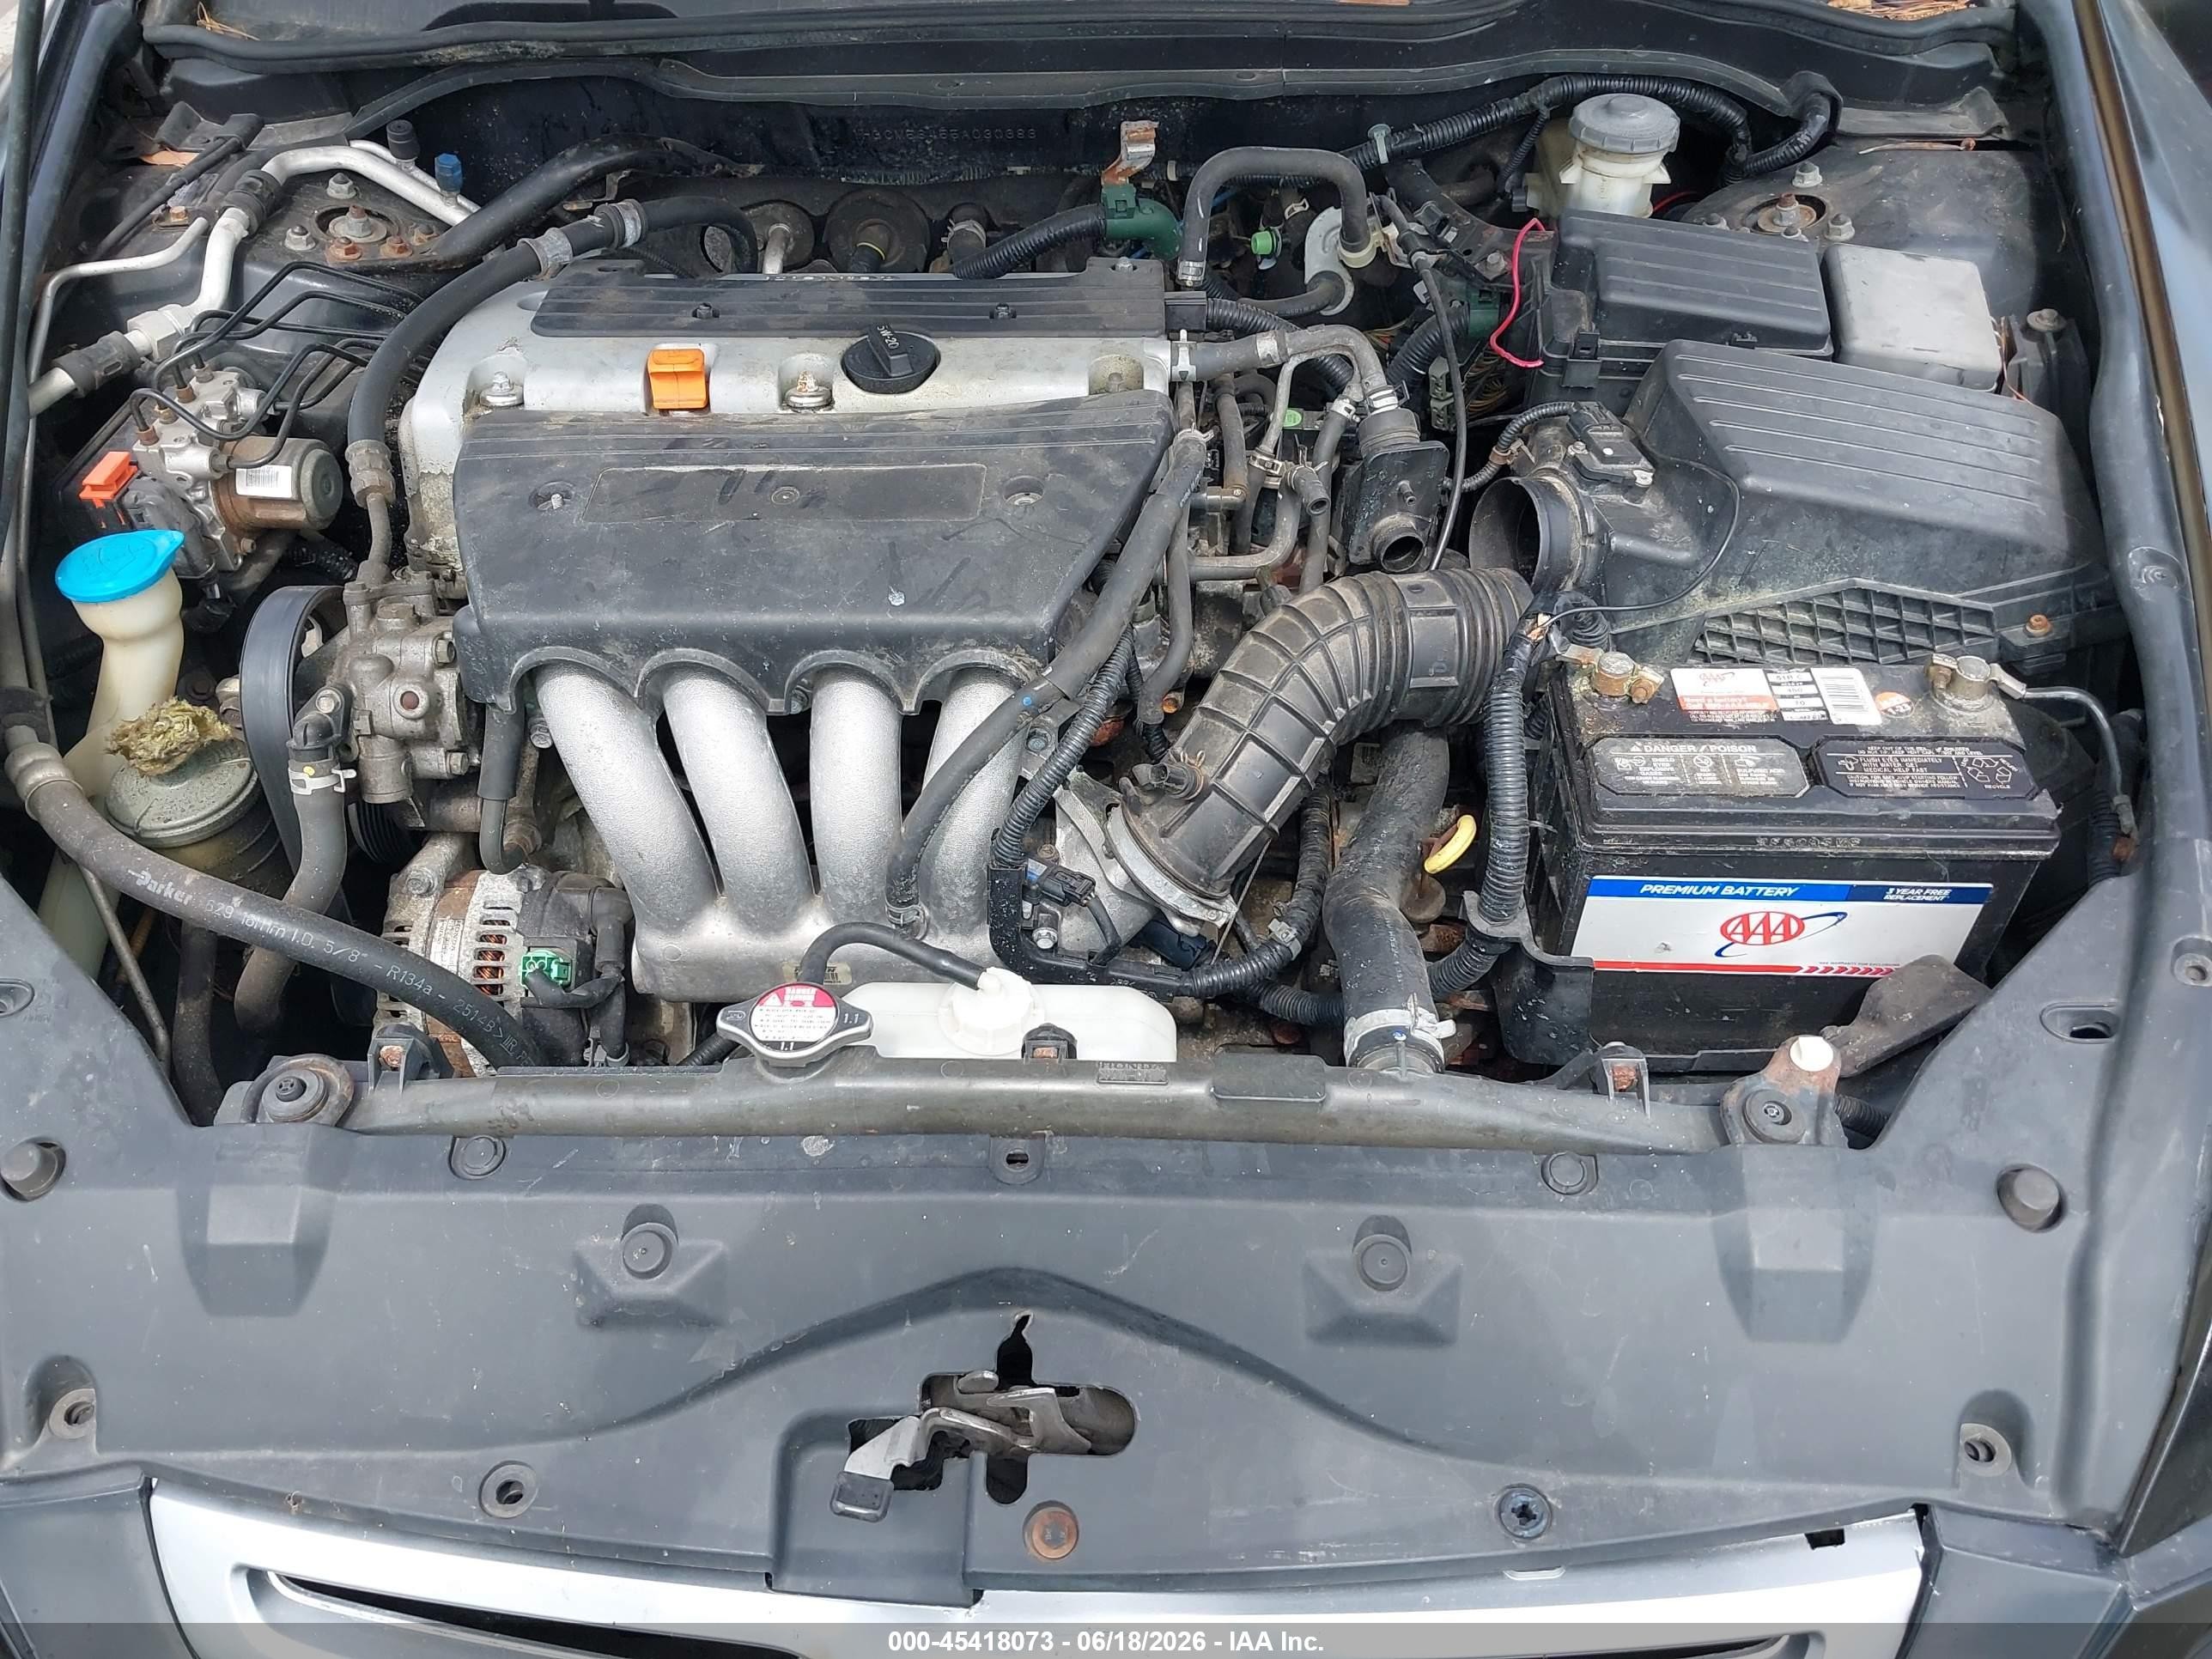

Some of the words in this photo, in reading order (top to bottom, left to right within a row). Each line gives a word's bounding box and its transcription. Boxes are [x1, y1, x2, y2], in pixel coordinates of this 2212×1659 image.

[1710, 744, 1757, 753] POISON
[129, 870, 193, 905] Parker
[1639, 884, 1719, 896] PREMIUM
[1720, 885, 1800, 897] BATTERY
[1723, 911, 1803, 945] AAA
[386, 964, 433, 995] R134a
[843, 1013, 860, 1024] 1.1
[780, 1042, 795, 1051] 1.1
